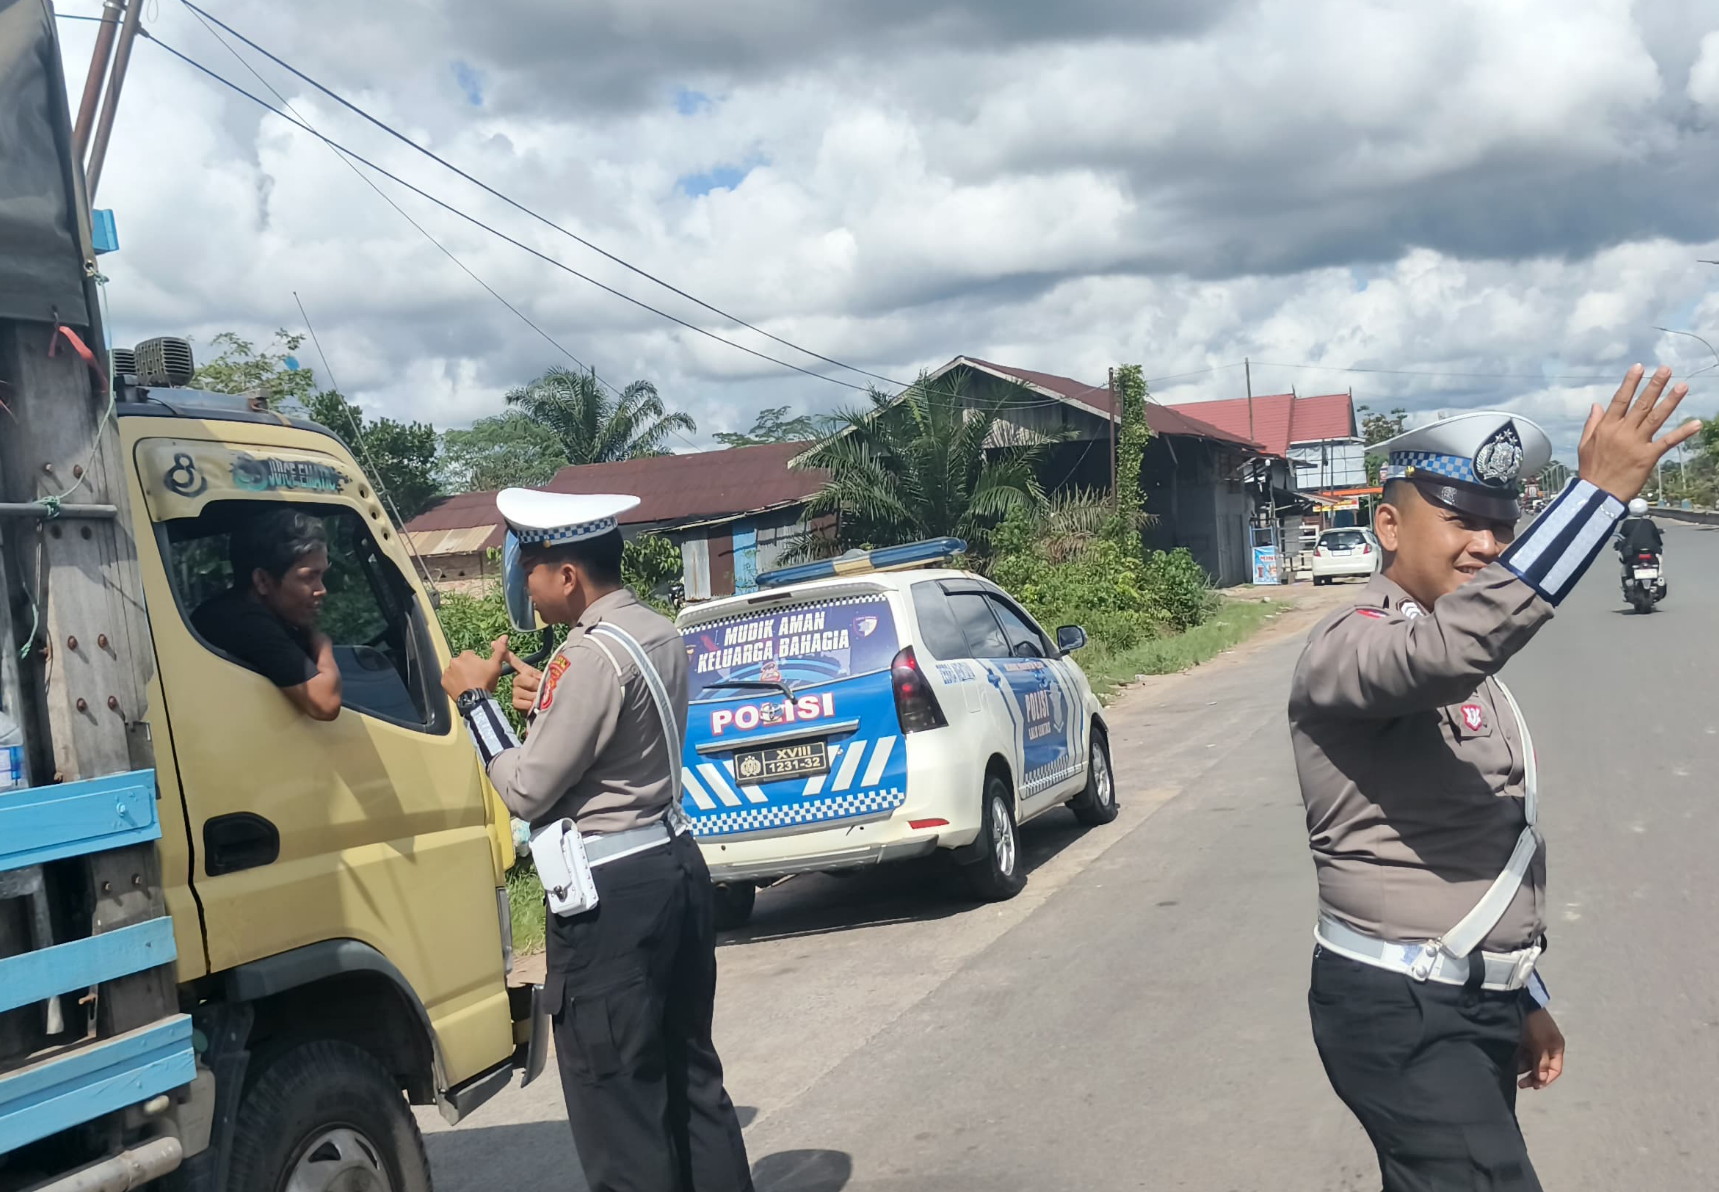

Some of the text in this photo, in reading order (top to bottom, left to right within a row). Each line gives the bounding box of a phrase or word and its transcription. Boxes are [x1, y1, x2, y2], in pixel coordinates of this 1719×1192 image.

[724, 611, 825, 646] MUDIK AMAN
[697, 629, 849, 673] KELUARGA BAHAGIA
[712, 692, 834, 735] POLISI
[1025, 689, 1050, 723] POLISI
[769, 757, 821, 773] 1231-32
[776, 745, 812, 760] XVIII
